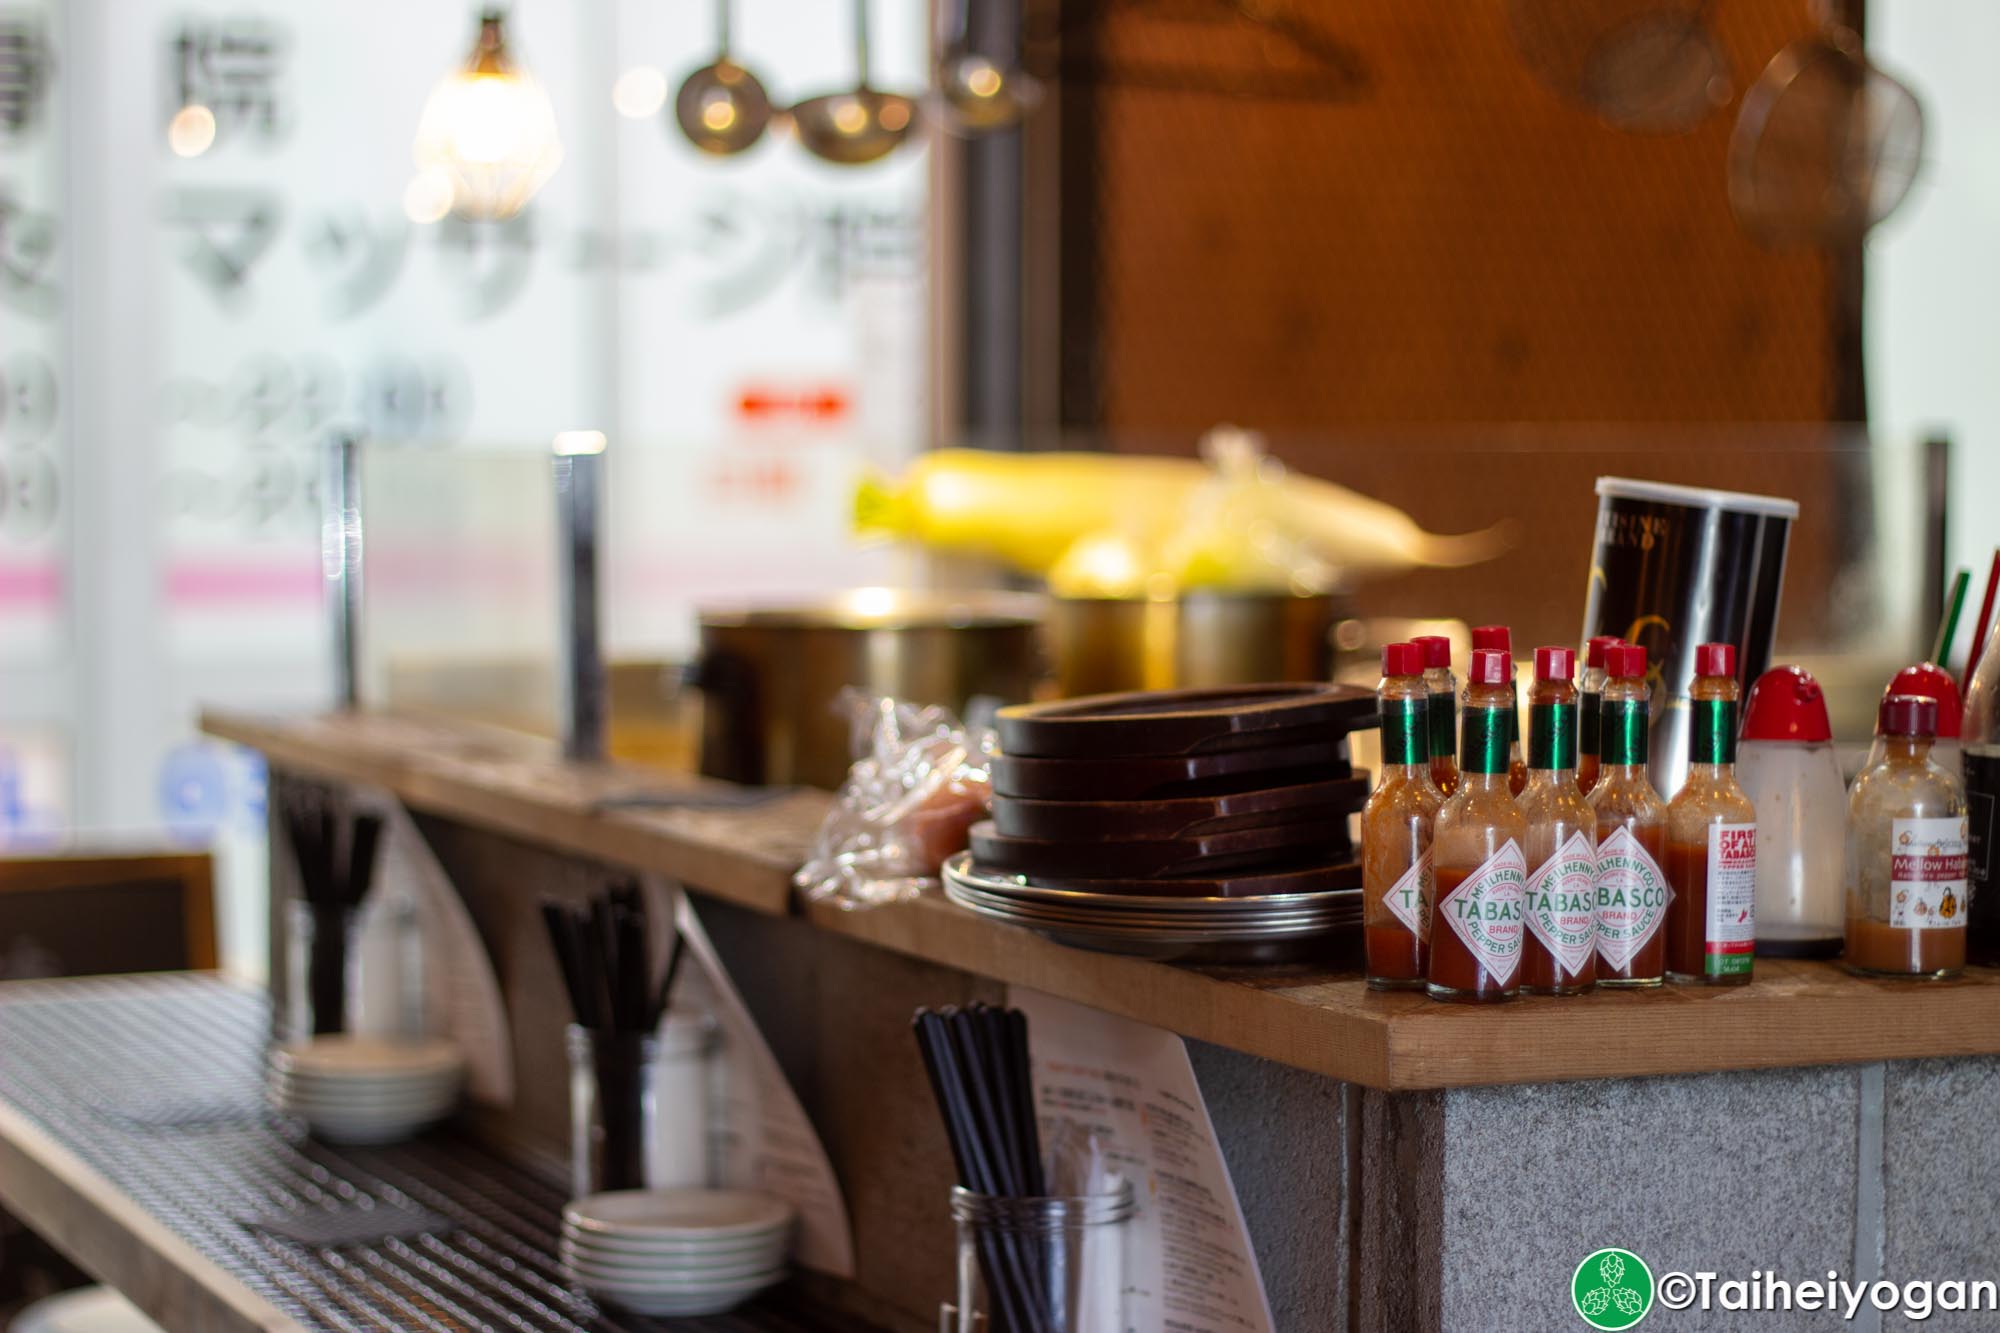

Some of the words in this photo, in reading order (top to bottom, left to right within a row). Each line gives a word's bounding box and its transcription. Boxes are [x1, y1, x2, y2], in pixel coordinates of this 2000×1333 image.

[1894, 857, 1943, 871] Mellow
[1559, 916, 1590, 925] BRAND
[1602, 910, 1638, 921] BRAND
[1488, 925, 1519, 934] BRAND
[1540, 912, 1577, 945] PEPPER
[1623, 909, 1655, 939] SAUCE
[1468, 920, 1505, 954] PEPPER
